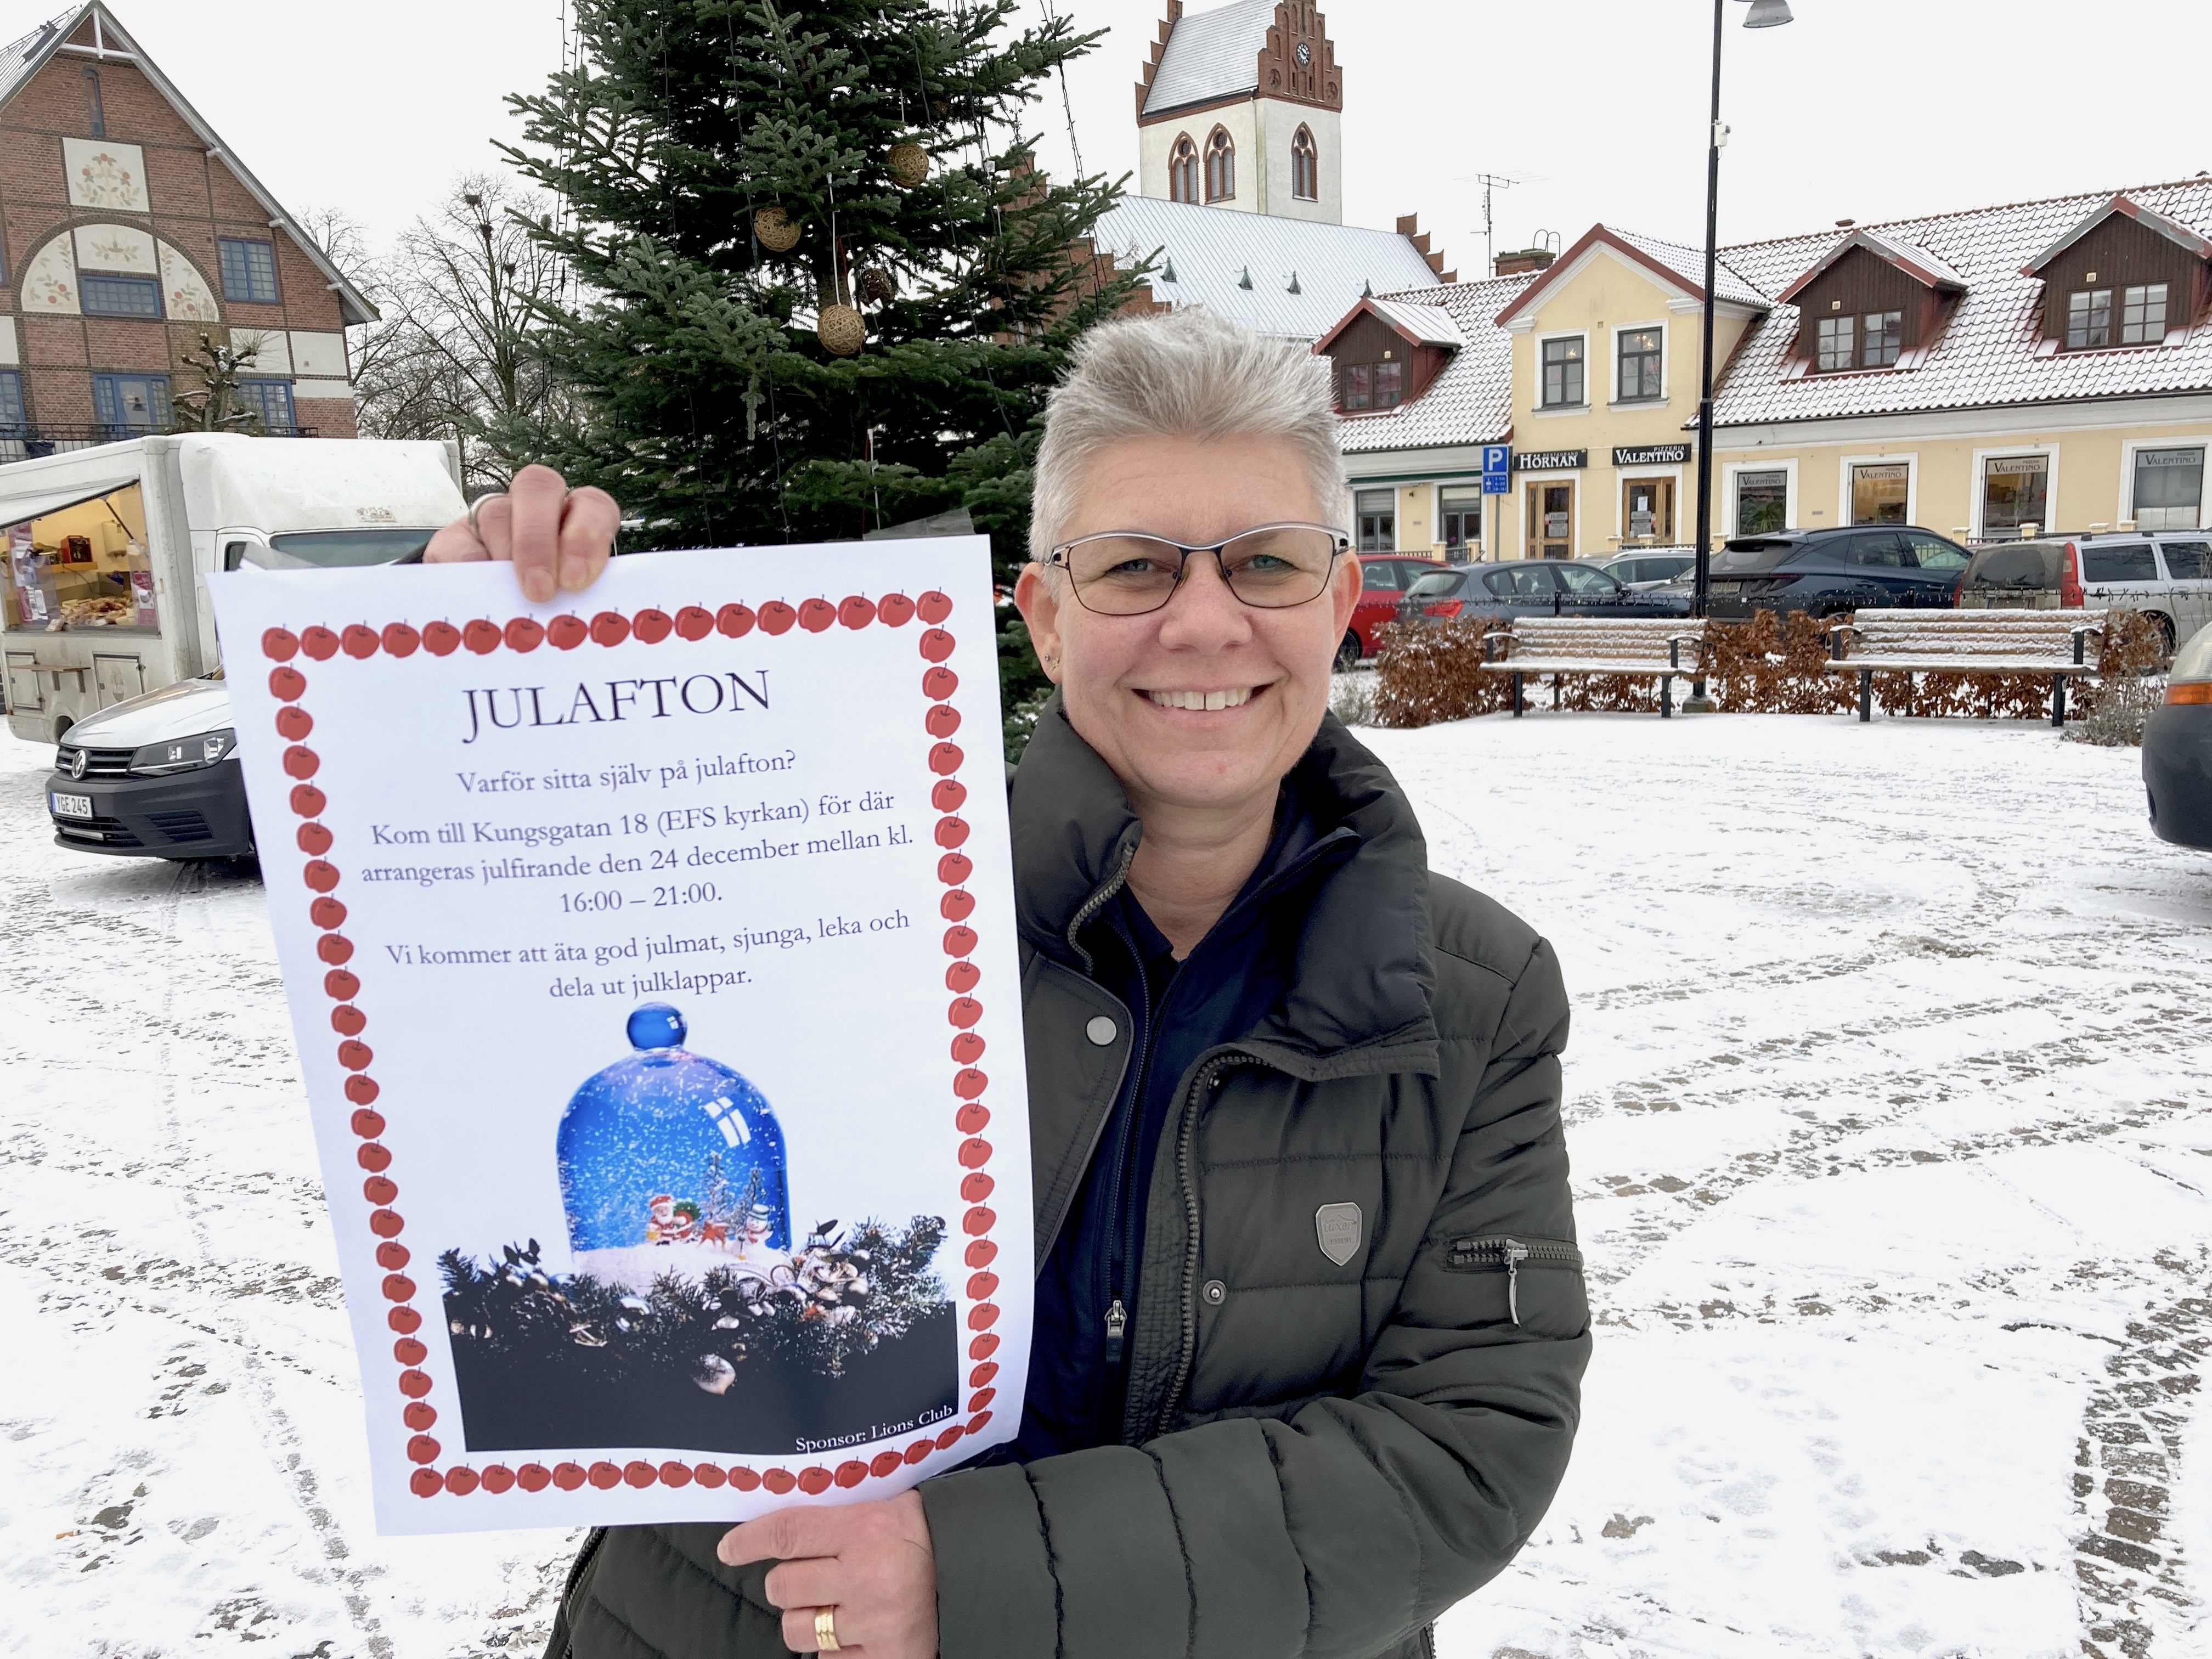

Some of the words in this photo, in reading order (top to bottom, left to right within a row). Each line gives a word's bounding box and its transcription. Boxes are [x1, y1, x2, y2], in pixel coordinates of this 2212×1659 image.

[1488, 449, 1503, 471] P
[1519, 453, 1578, 470] HÖRNAN
[1615, 449, 1684, 464] VALENTINO
[1994, 462, 2040, 472] VALENTINO
[2146, 454, 2196, 465] VALENTINO
[1742, 476, 1781, 486] VALENTINO
[1860, 469, 1901, 479] VALENTINO
[461, 669, 770, 744] JULAFTON
[455, 770, 535, 793] Varför
[543, 769, 592, 790] sitta
[599, 763, 652, 792] själv
[659, 759, 689, 789] på
[695, 749, 796, 785] julafton?
[56, 795, 70, 812] YGE
[71, 797, 88, 815] 245
[370, 825, 431, 845] Kom
[437, 822, 466, 844] till
[471, 822, 613, 848] Kungsgatan
[619, 813, 648, 835] 18
[657, 806, 716, 838] (EFS
[723, 798, 809, 831] kyrkan)
[818, 794, 852, 816] för
[859, 791, 895, 811] där
[362, 866, 475, 887] arrangeras
[481, 855, 592, 886] julfirande
[599, 853, 644, 874] den
[650, 848, 679, 870] 24
[686, 838, 800, 867] december
[806, 830, 881, 854] mellan
[887, 824, 913, 846] kl.
[559, 890, 623, 913] 16:00
[652, 882, 723, 907] 21:00.
[385, 945, 413, 964] Vi
[417, 944, 512, 964] kommer
[518, 947, 548, 963] att
[554, 942, 589, 962] äta
[594, 936, 639, 967] god
[645, 934, 726, 963] julmat,
[732, 927, 811, 953] sjunga,
[817, 916, 863, 938] leka
[869, 909, 910, 932] och
[549, 977, 596, 997] dela
[600, 979, 627, 995] ut
[631, 969, 752, 1000] julklappar.
[795, 1431, 866, 1454] Sponsor:
[871, 1419, 914, 1440] Lions
[918, 1405, 953, 1425] Club
